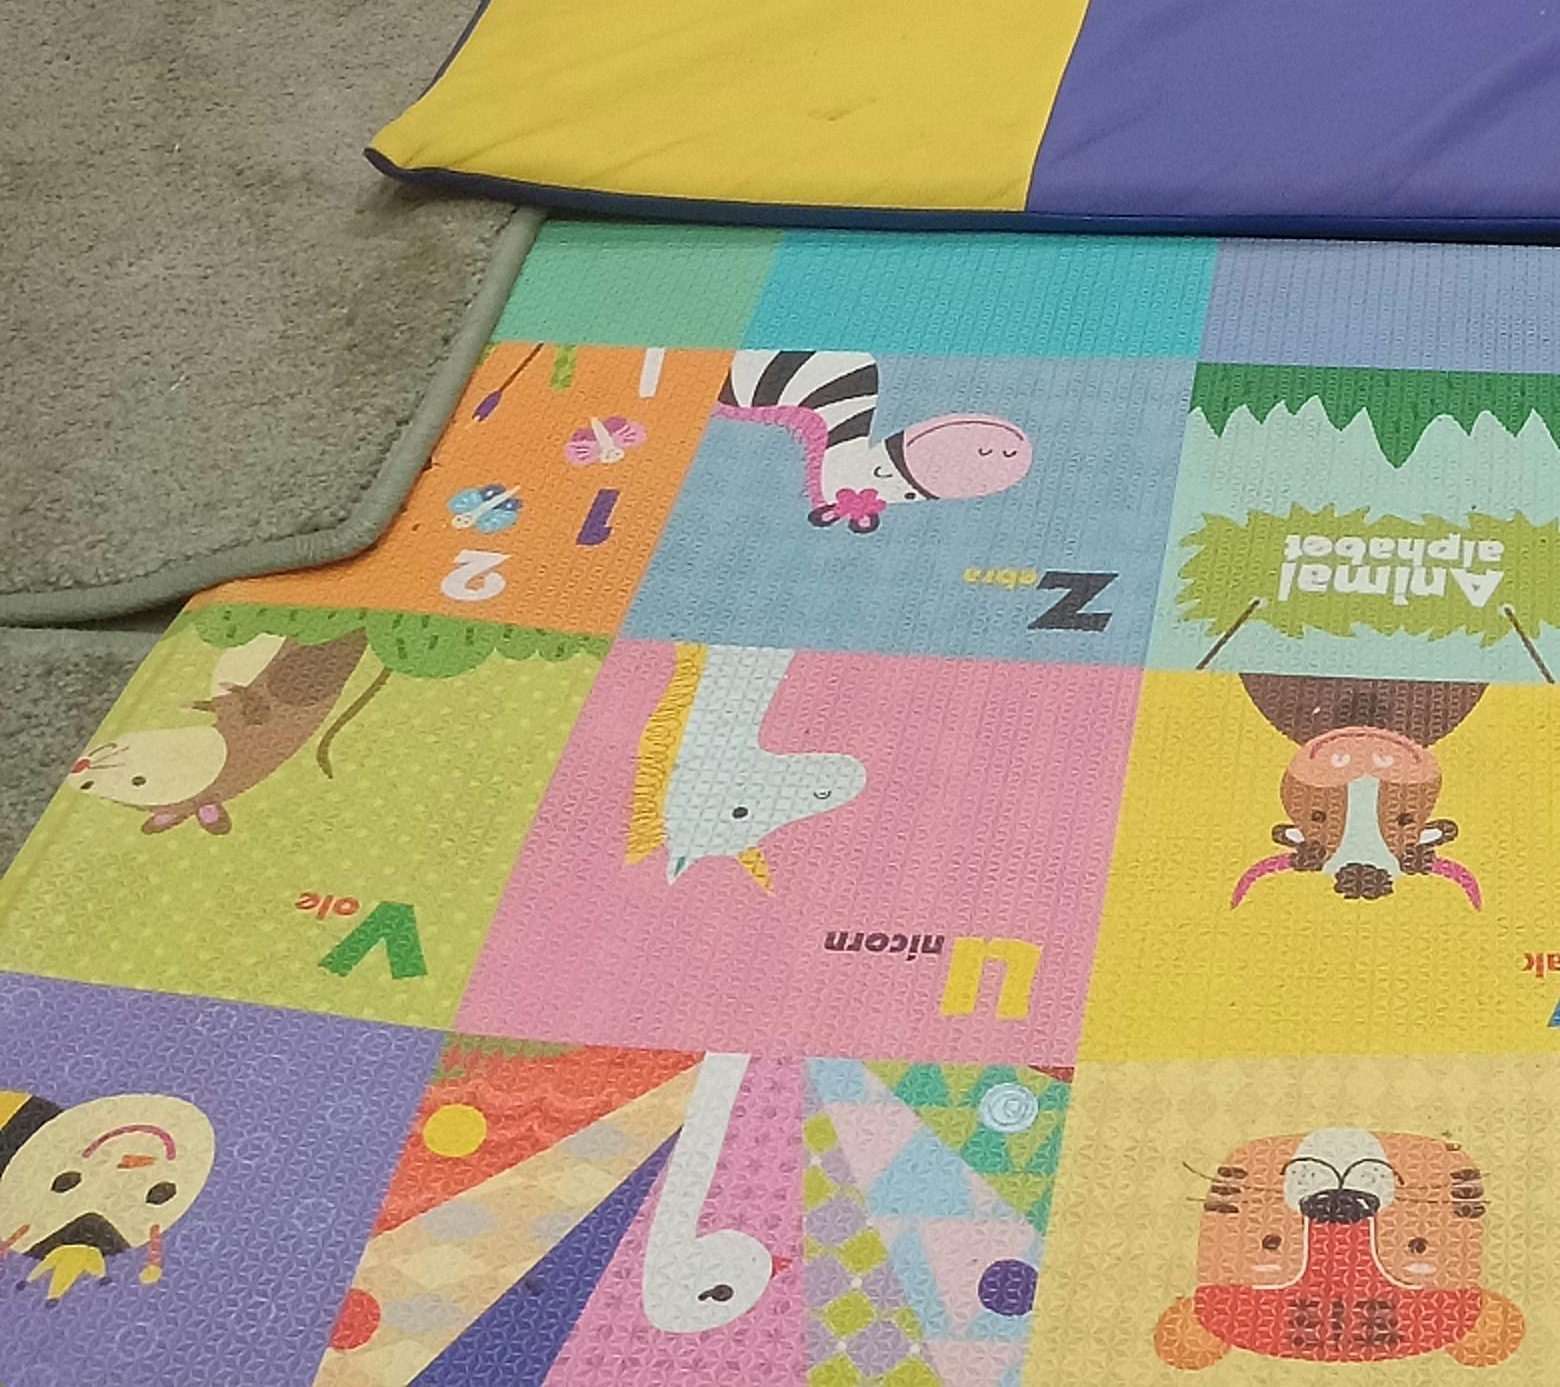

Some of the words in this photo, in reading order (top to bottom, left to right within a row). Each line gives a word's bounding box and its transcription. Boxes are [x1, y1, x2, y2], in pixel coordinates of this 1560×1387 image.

[575, 489, 621, 546] 1
[1284, 533, 1506, 563] alphabet
[440, 548, 513, 602] 2
[1278, 560, 1506, 609] Animal
